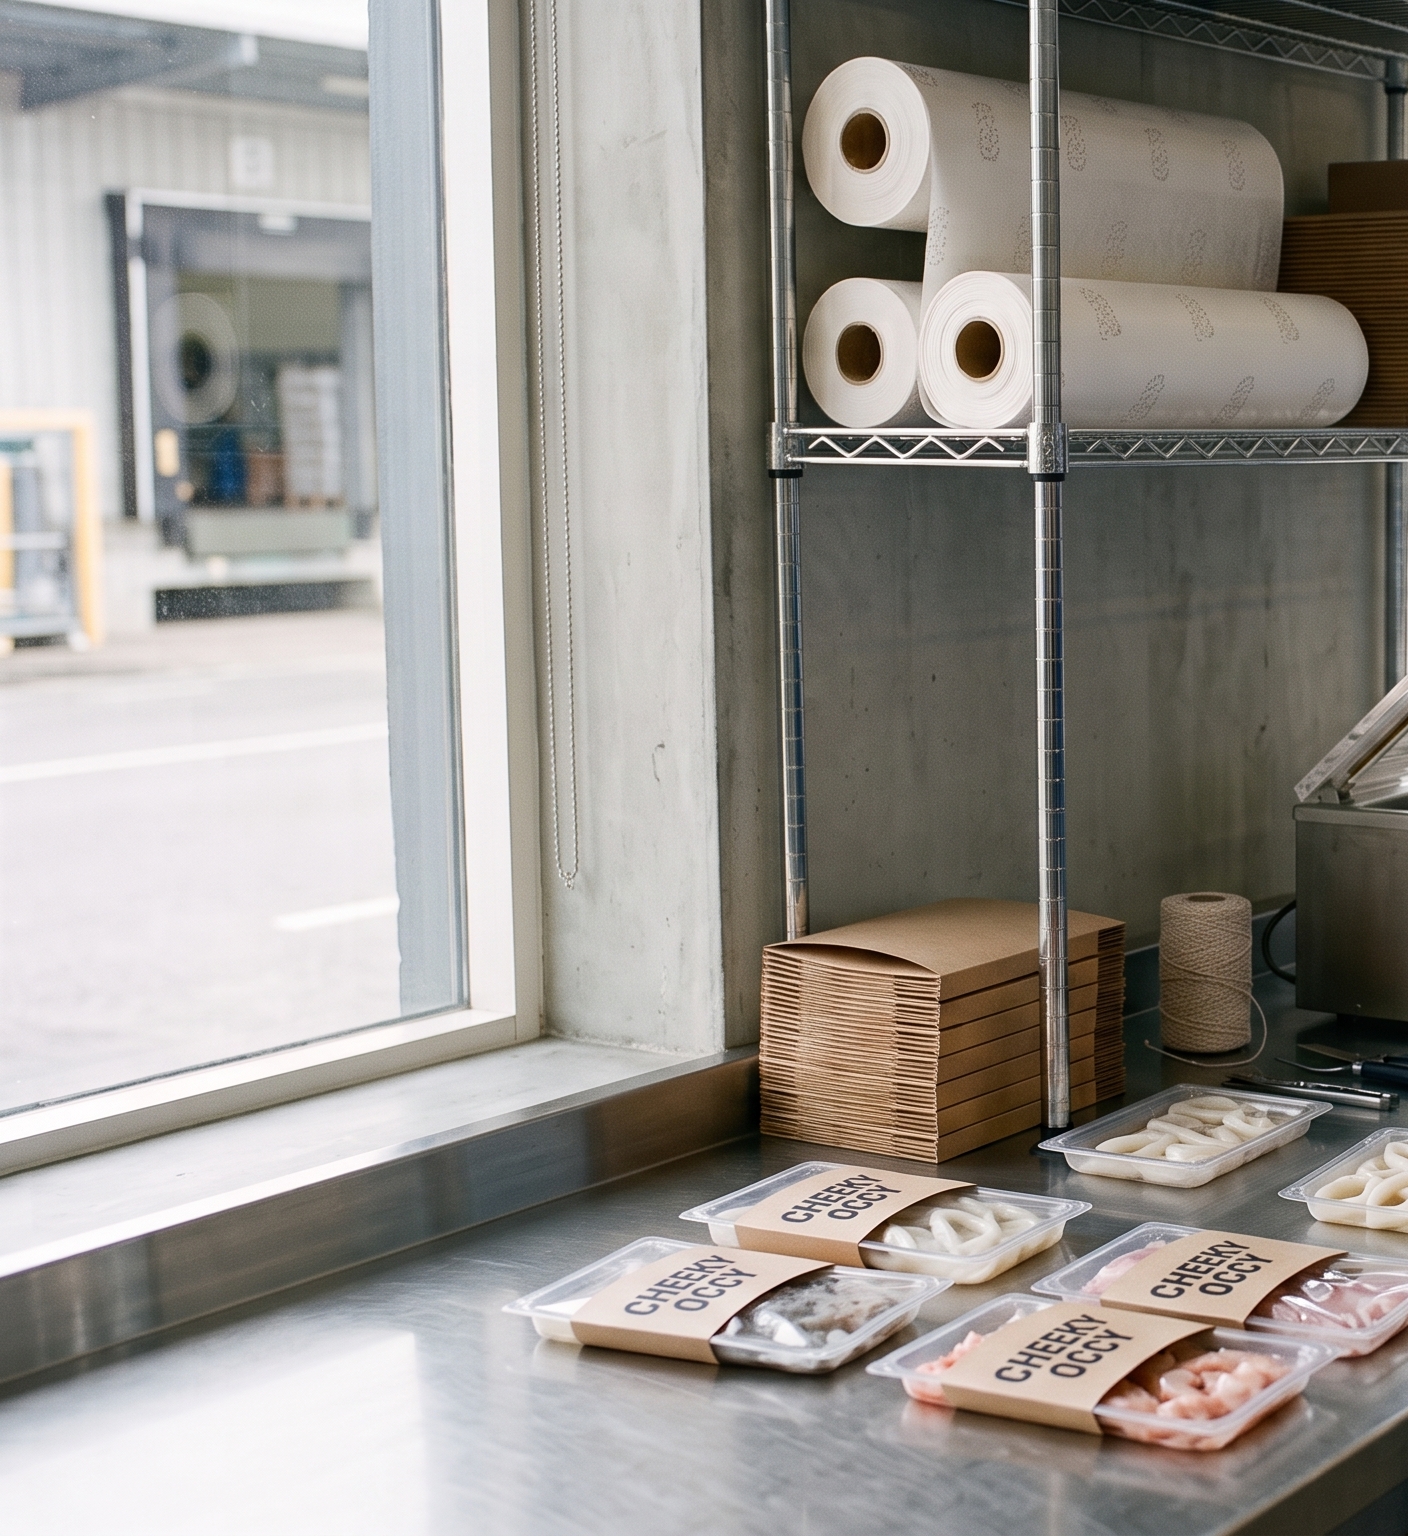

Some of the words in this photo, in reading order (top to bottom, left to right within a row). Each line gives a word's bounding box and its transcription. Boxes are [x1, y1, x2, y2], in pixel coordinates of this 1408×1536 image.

[781, 1173, 881, 1223] CHEEKY
[827, 1184, 902, 1220] OCCY
[624, 1254, 736, 1316] CHEEKY
[673, 1267, 758, 1311] OCCY
[1150, 1240, 1250, 1299] CHEEKY
[1198, 1253, 1274, 1296] OCCY
[995, 1314, 1108, 1383] CHEEKY
[1050, 1327, 1134, 1378] OCCY
